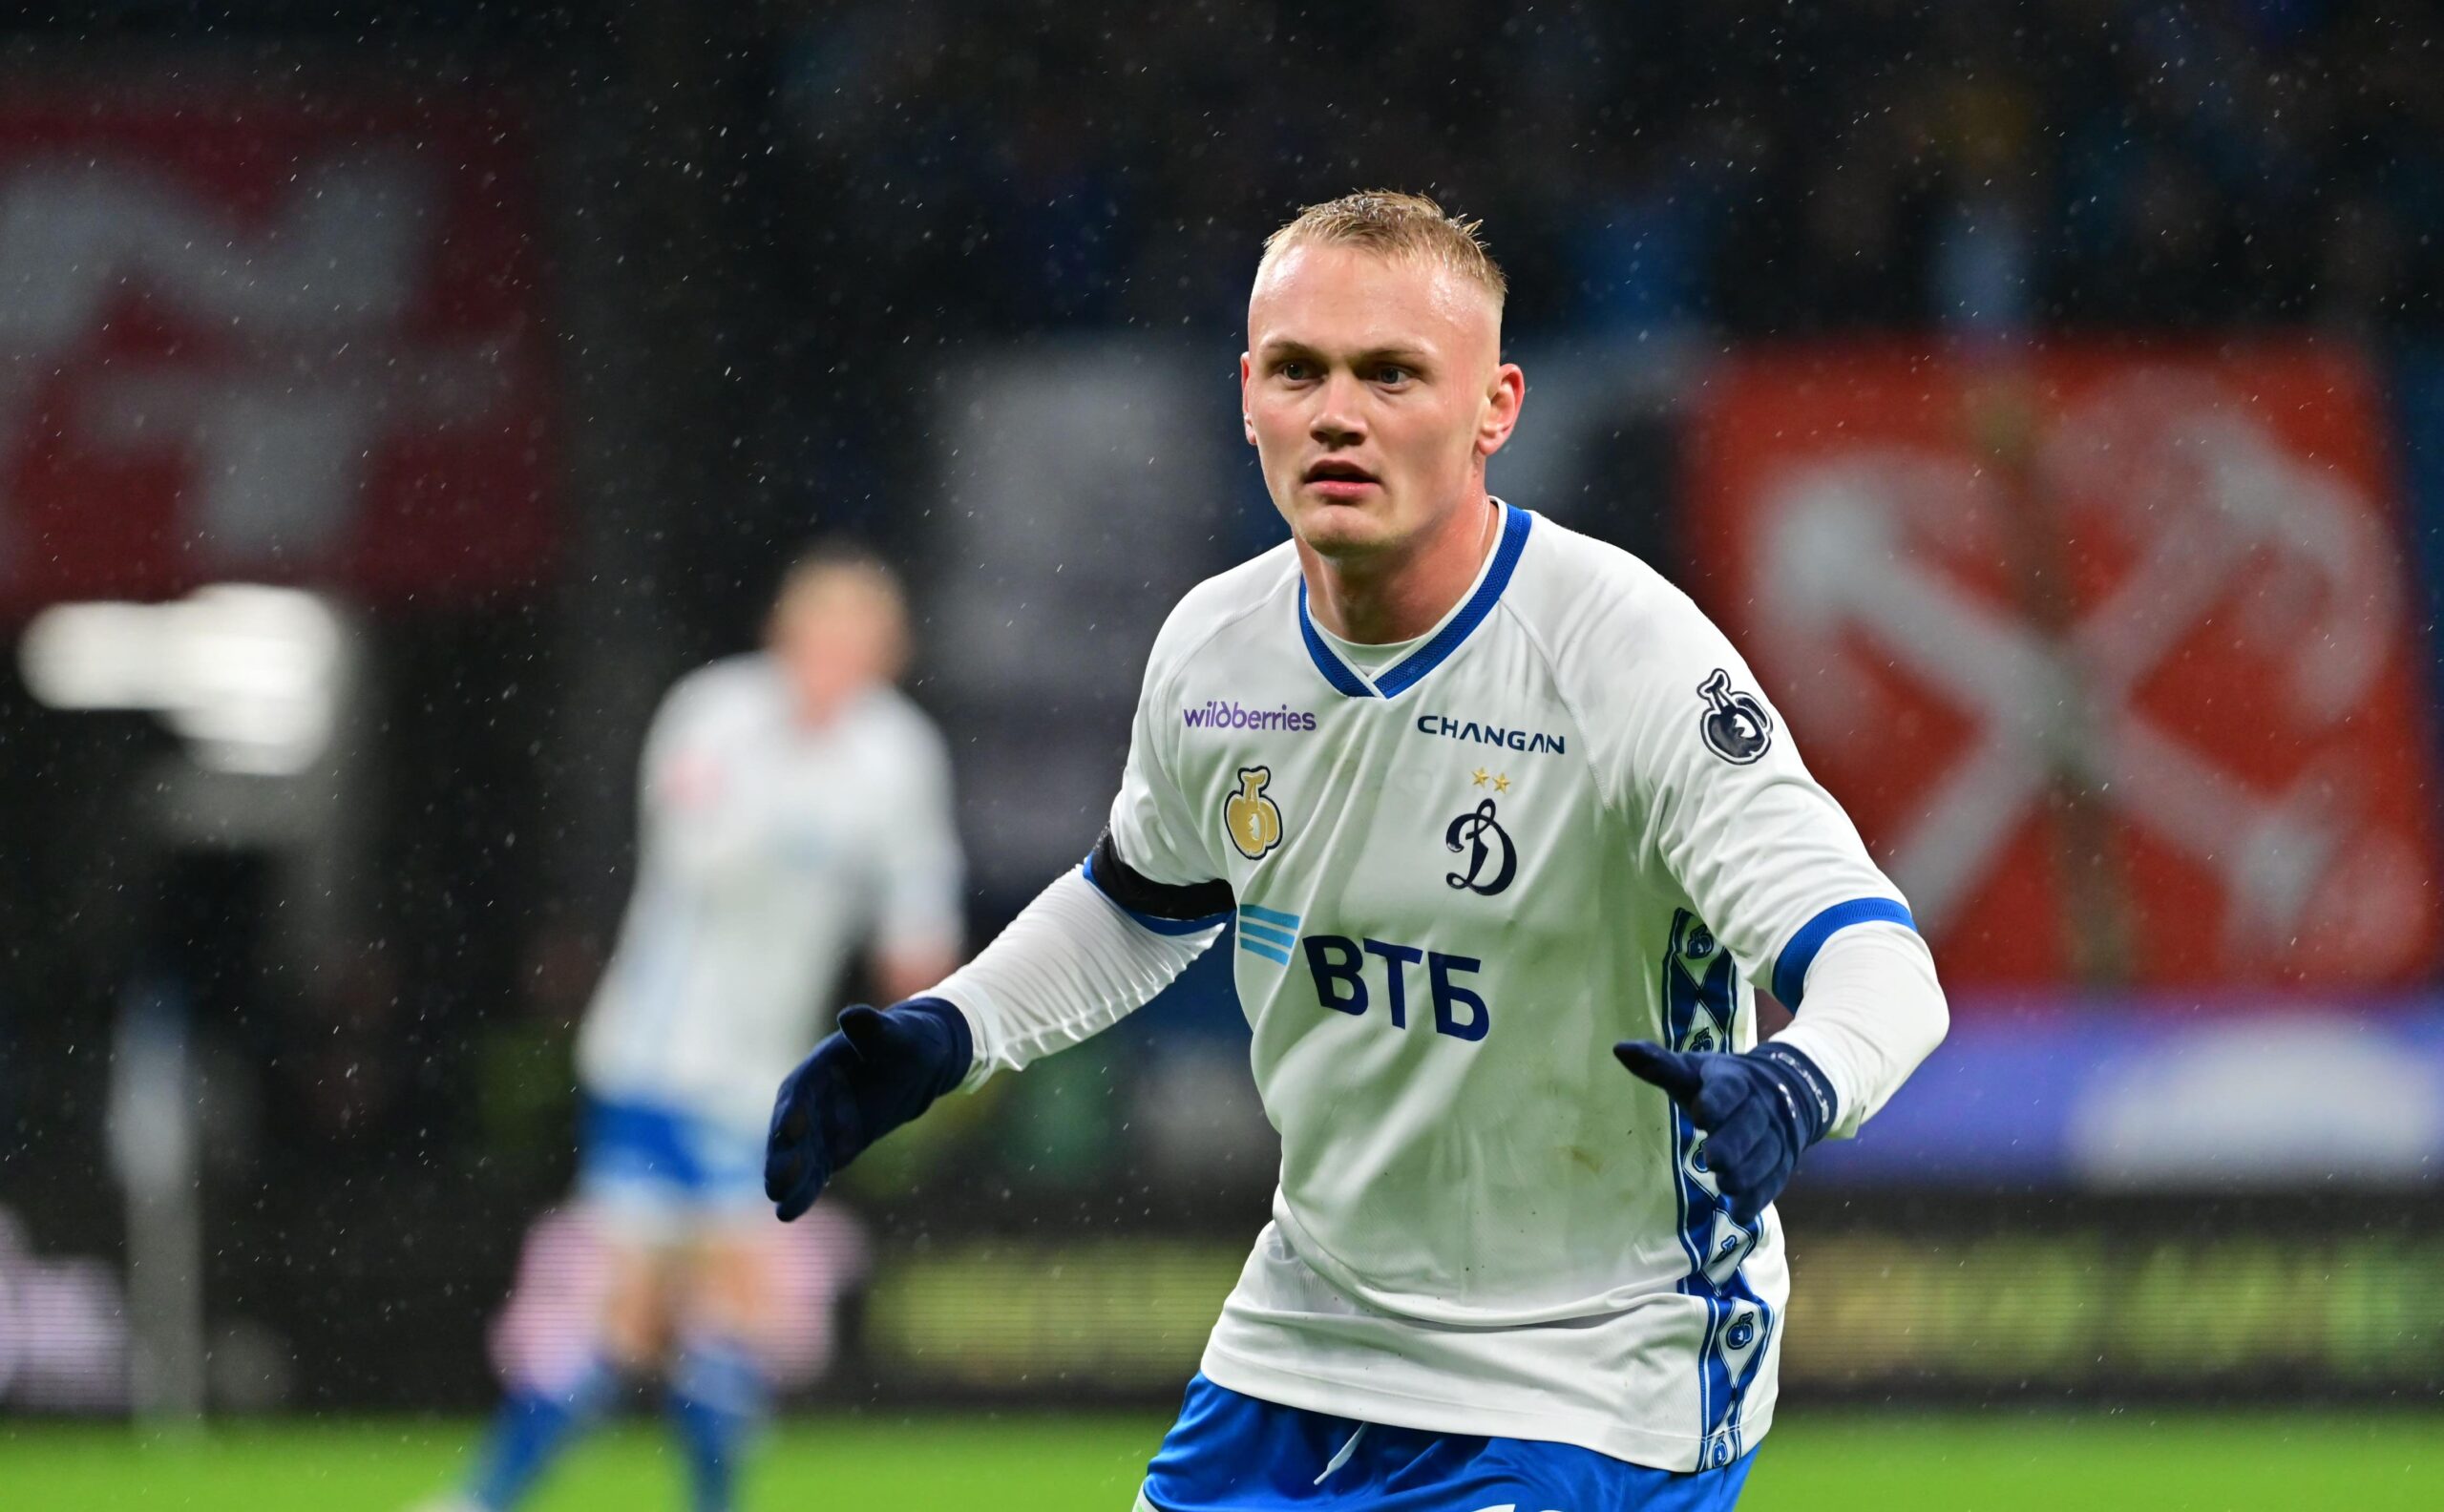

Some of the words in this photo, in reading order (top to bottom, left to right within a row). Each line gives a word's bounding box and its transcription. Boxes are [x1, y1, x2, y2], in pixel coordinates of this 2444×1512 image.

[1184, 701, 1317, 731] wildberries
[1417, 715, 1565, 754] CHANGAN
[1302, 934, 1489, 1041] ВТБ
